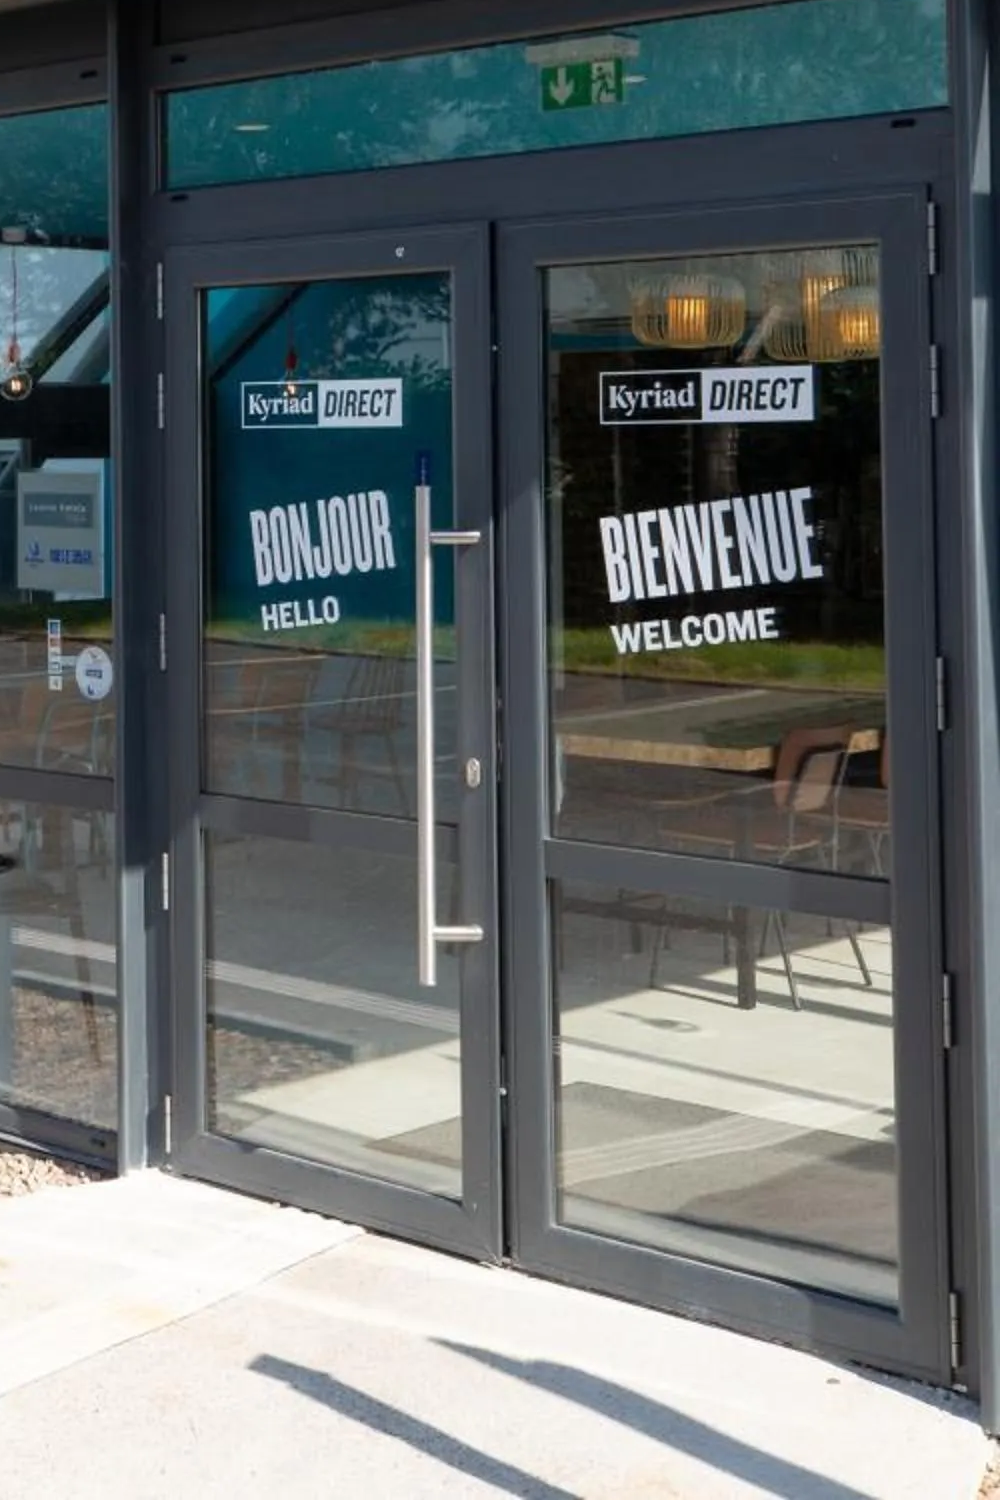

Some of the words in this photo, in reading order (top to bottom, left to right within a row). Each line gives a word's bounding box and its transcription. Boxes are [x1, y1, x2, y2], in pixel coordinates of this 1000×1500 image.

[249, 391, 314, 421] Kyriad
[324, 389, 397, 418] DIRECT
[608, 381, 696, 417] Kyriad
[709, 378, 805, 412] DIRECT
[250, 489, 396, 587] BONJOUR
[600, 486, 824, 603] BIENVENUE
[261, 595, 340, 631] HELLO
[610, 607, 780, 655] WELCOME
